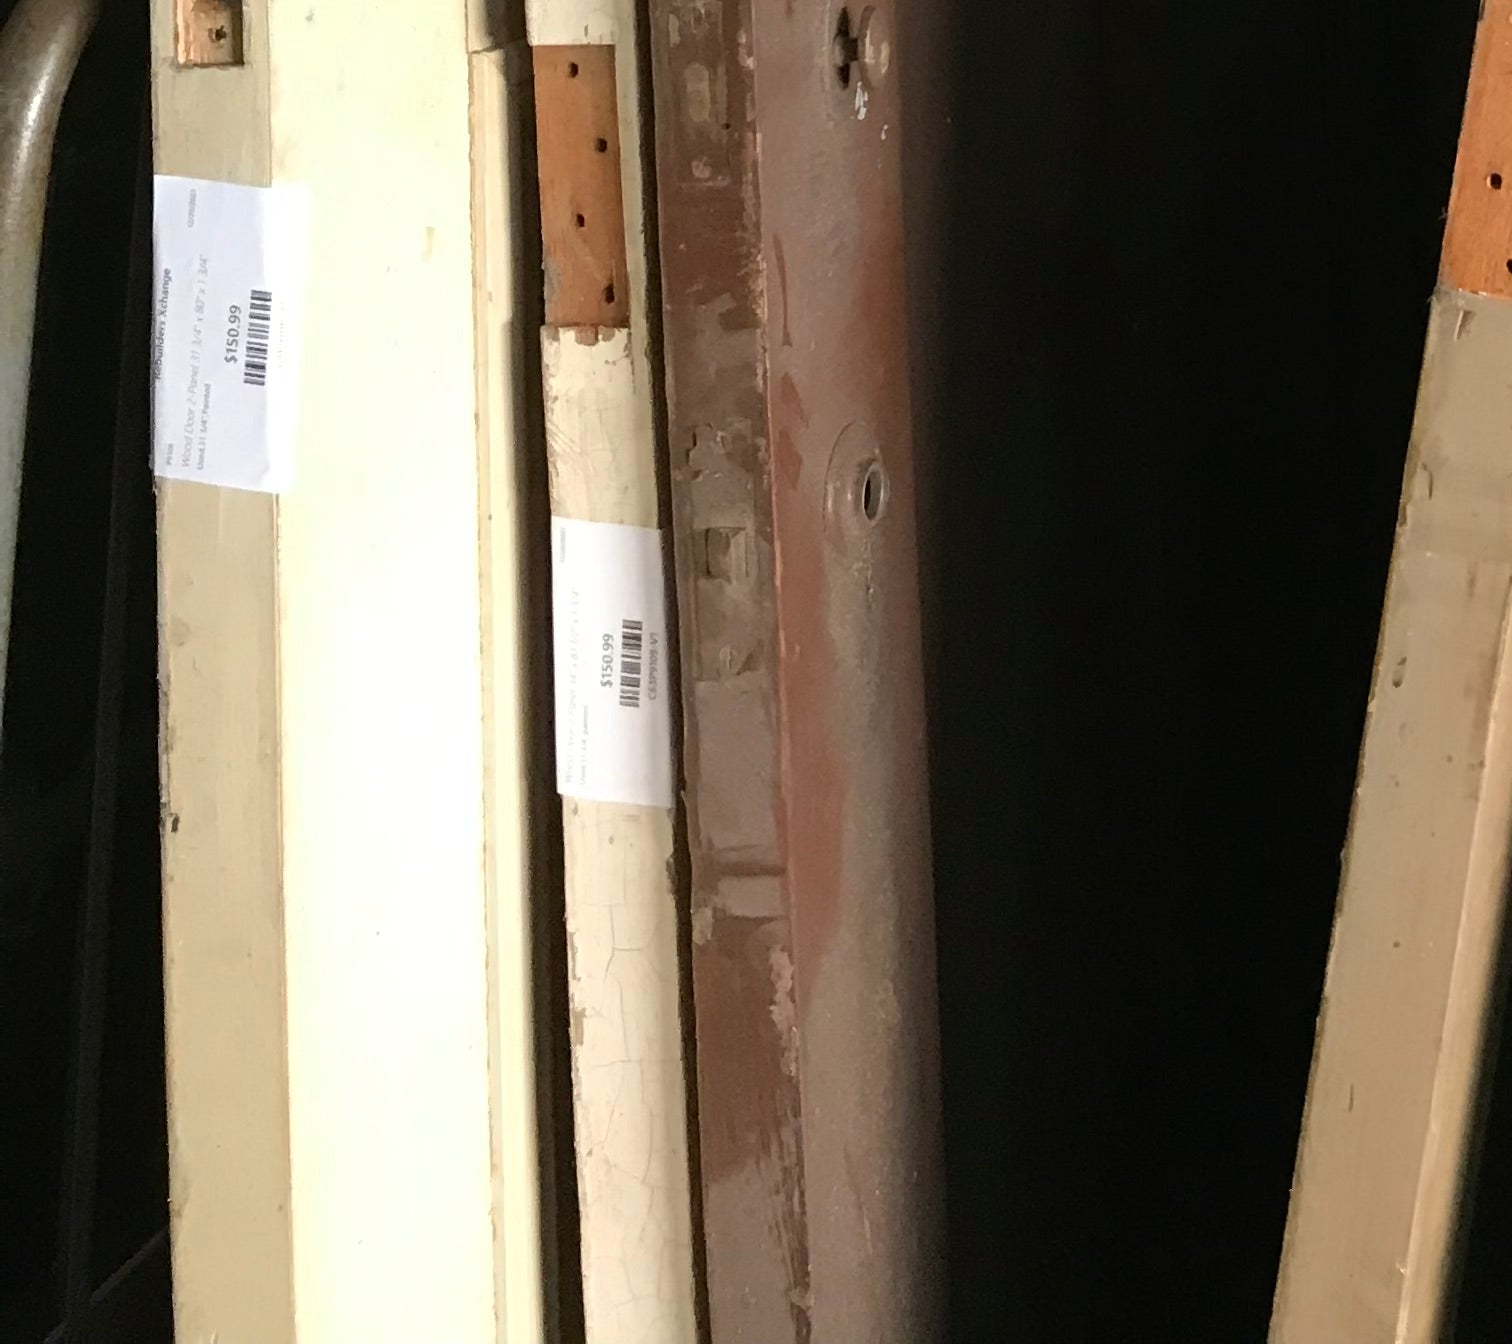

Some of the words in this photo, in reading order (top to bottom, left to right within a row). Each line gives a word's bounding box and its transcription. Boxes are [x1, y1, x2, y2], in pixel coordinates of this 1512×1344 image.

[158, 268, 172, 317] Xchange
[224, 305, 241, 363] $150.99
[600, 633, 614, 688] $150.99
